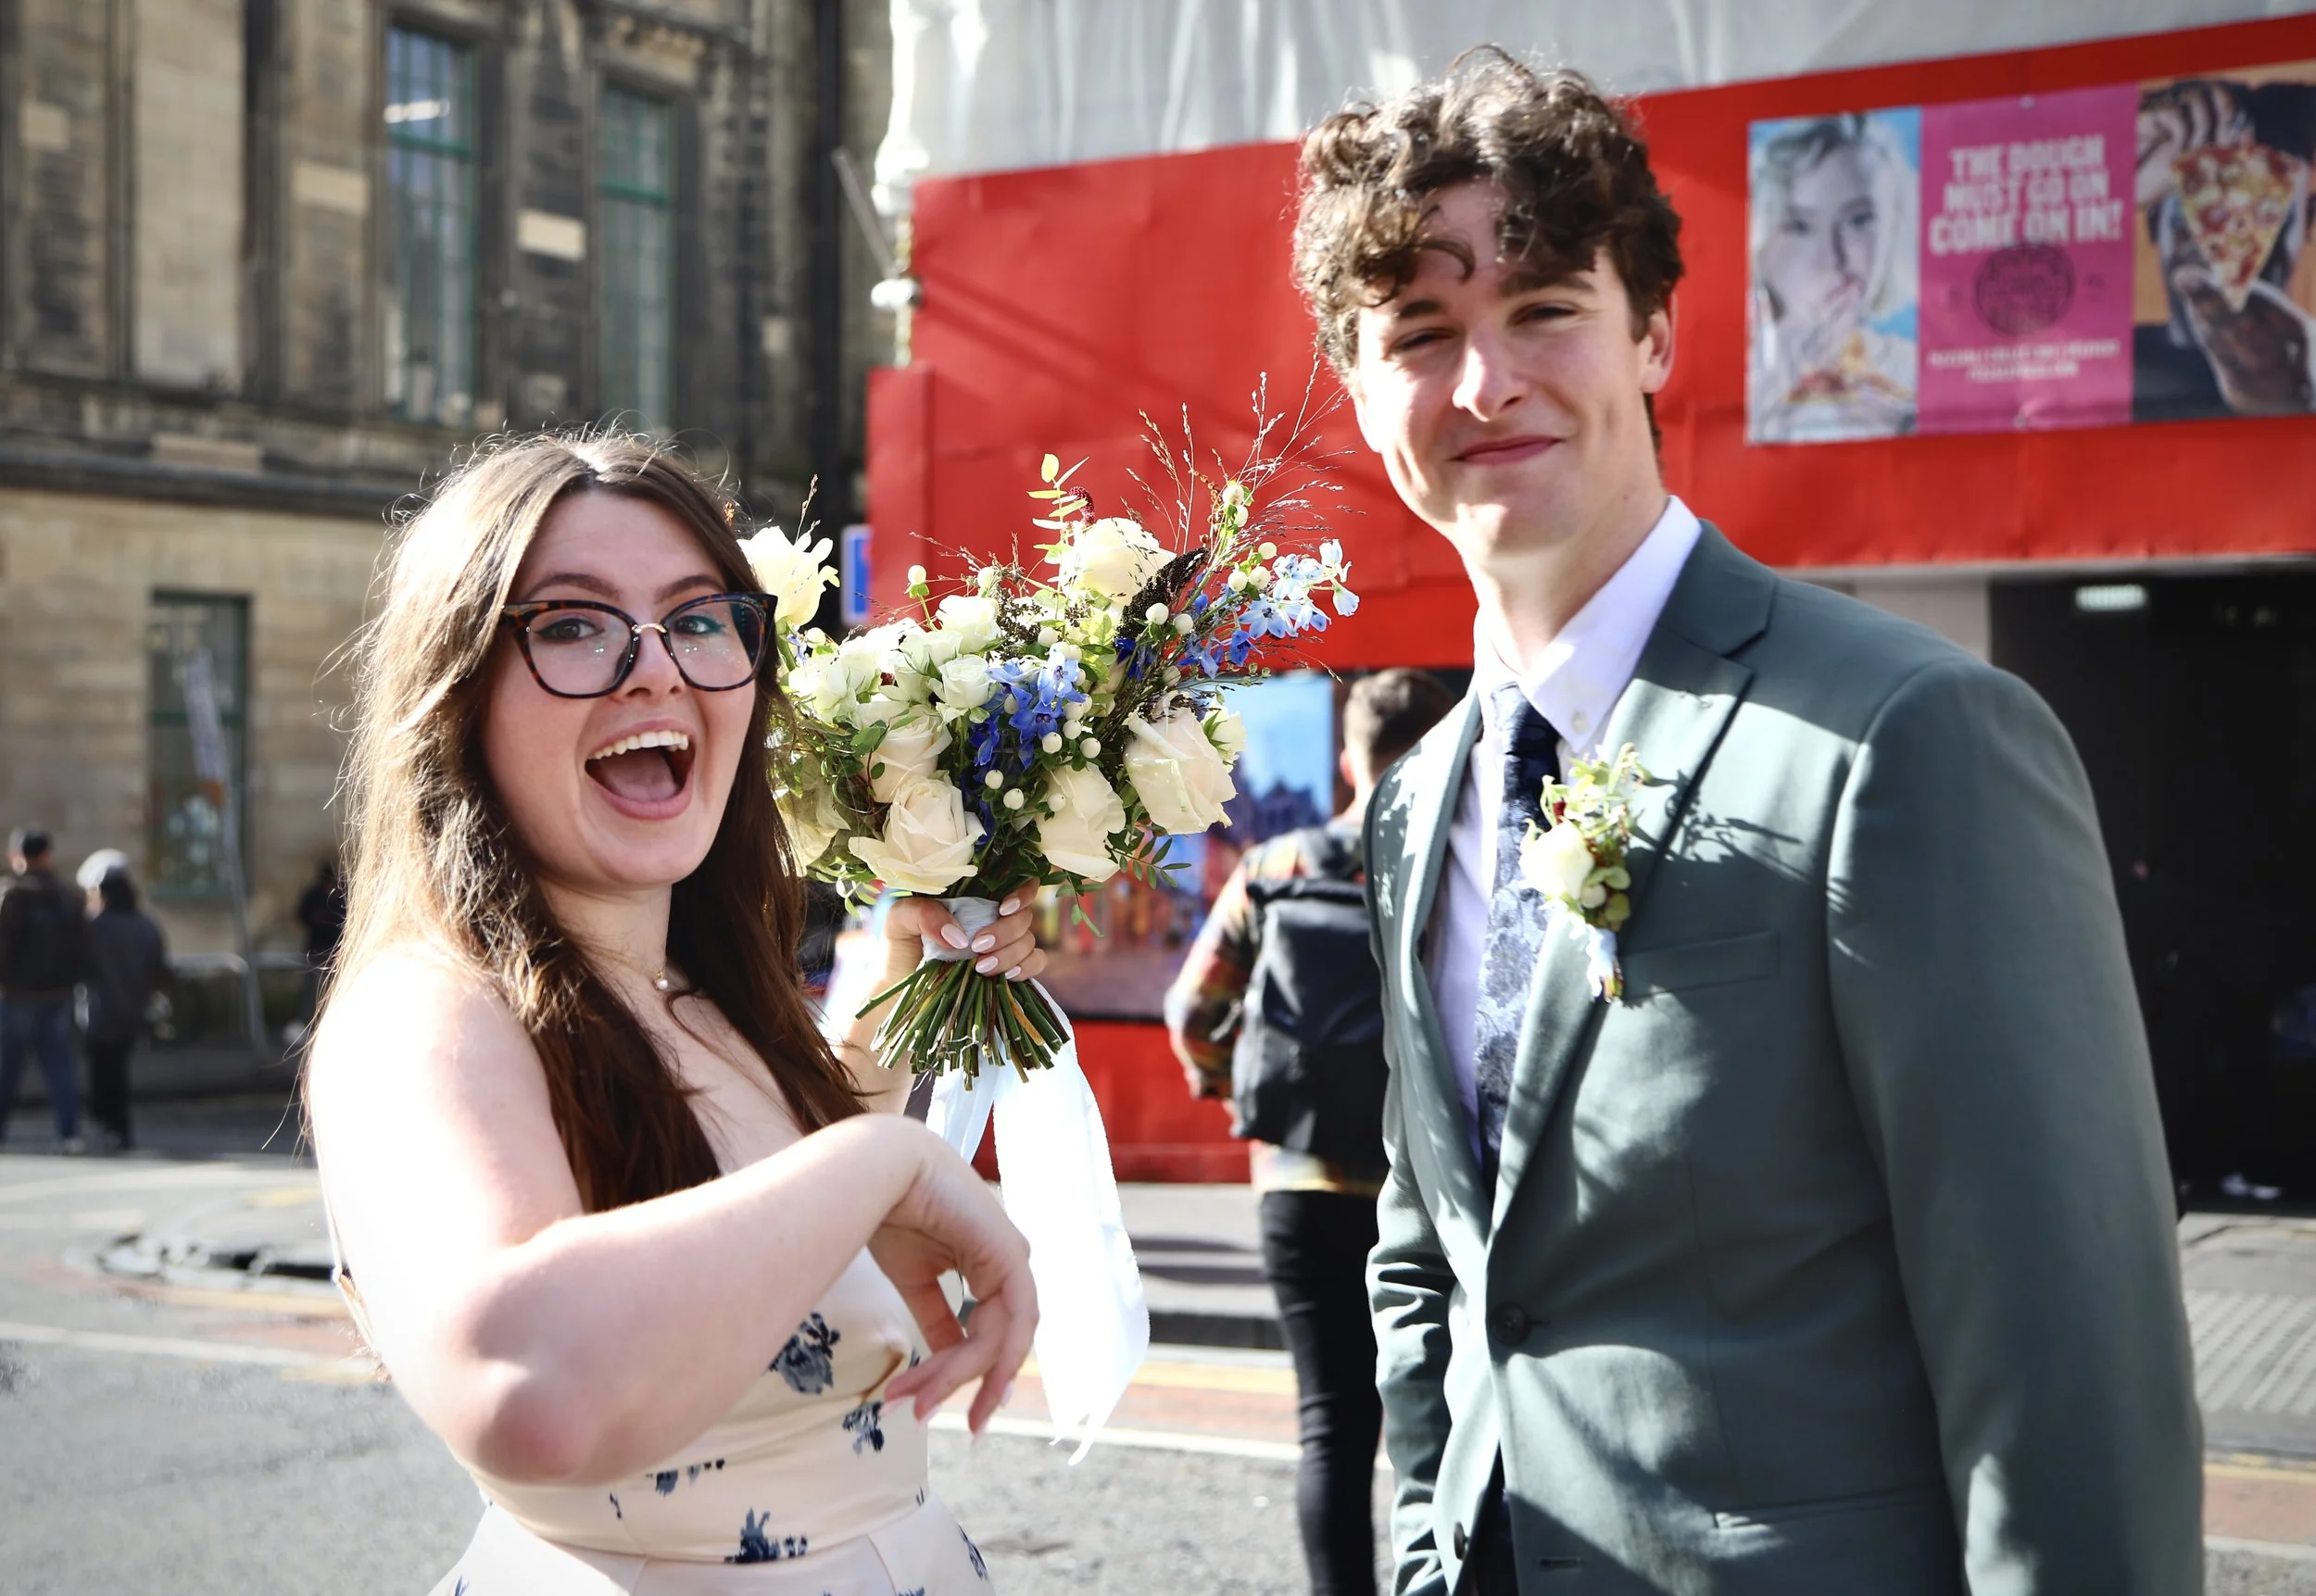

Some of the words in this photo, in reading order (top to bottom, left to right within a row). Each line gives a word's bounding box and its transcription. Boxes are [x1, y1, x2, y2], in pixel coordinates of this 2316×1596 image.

[1949, 145, 2003, 178] THE
[2008, 135, 2105, 170] DOUGH
[1945, 175, 2021, 211] MUST
[2026, 170, 2065, 206] GO
[2069, 170, 2108, 201] ON
[1930, 211, 2017, 255] COME
[2023, 207, 2071, 244] ON
[2075, 198, 2122, 242] IN!
